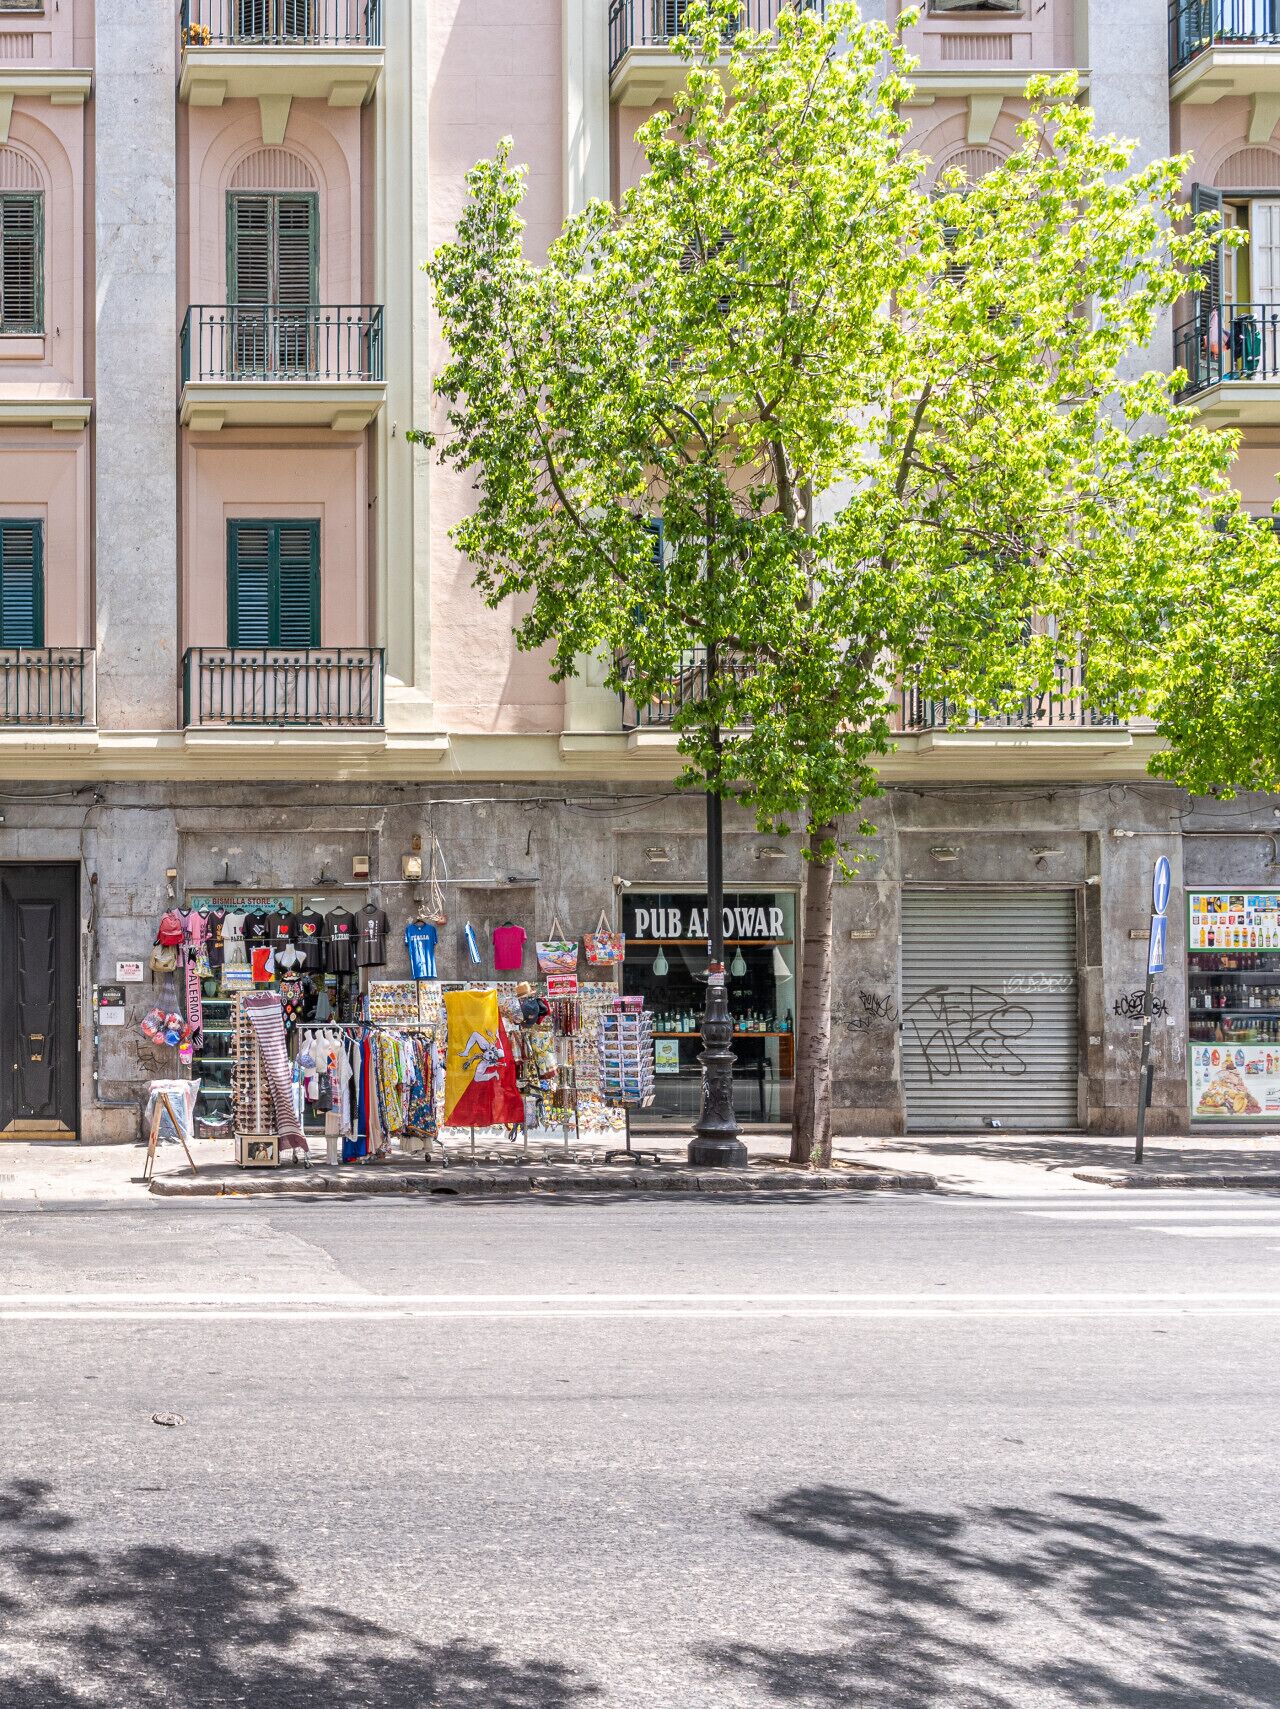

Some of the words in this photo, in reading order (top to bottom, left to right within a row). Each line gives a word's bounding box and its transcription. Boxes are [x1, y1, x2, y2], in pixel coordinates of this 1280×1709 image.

[212, 897, 245, 905] BISMILLA
[247, 897, 271, 905] STORE
[634, 908, 682, 938] PUB
